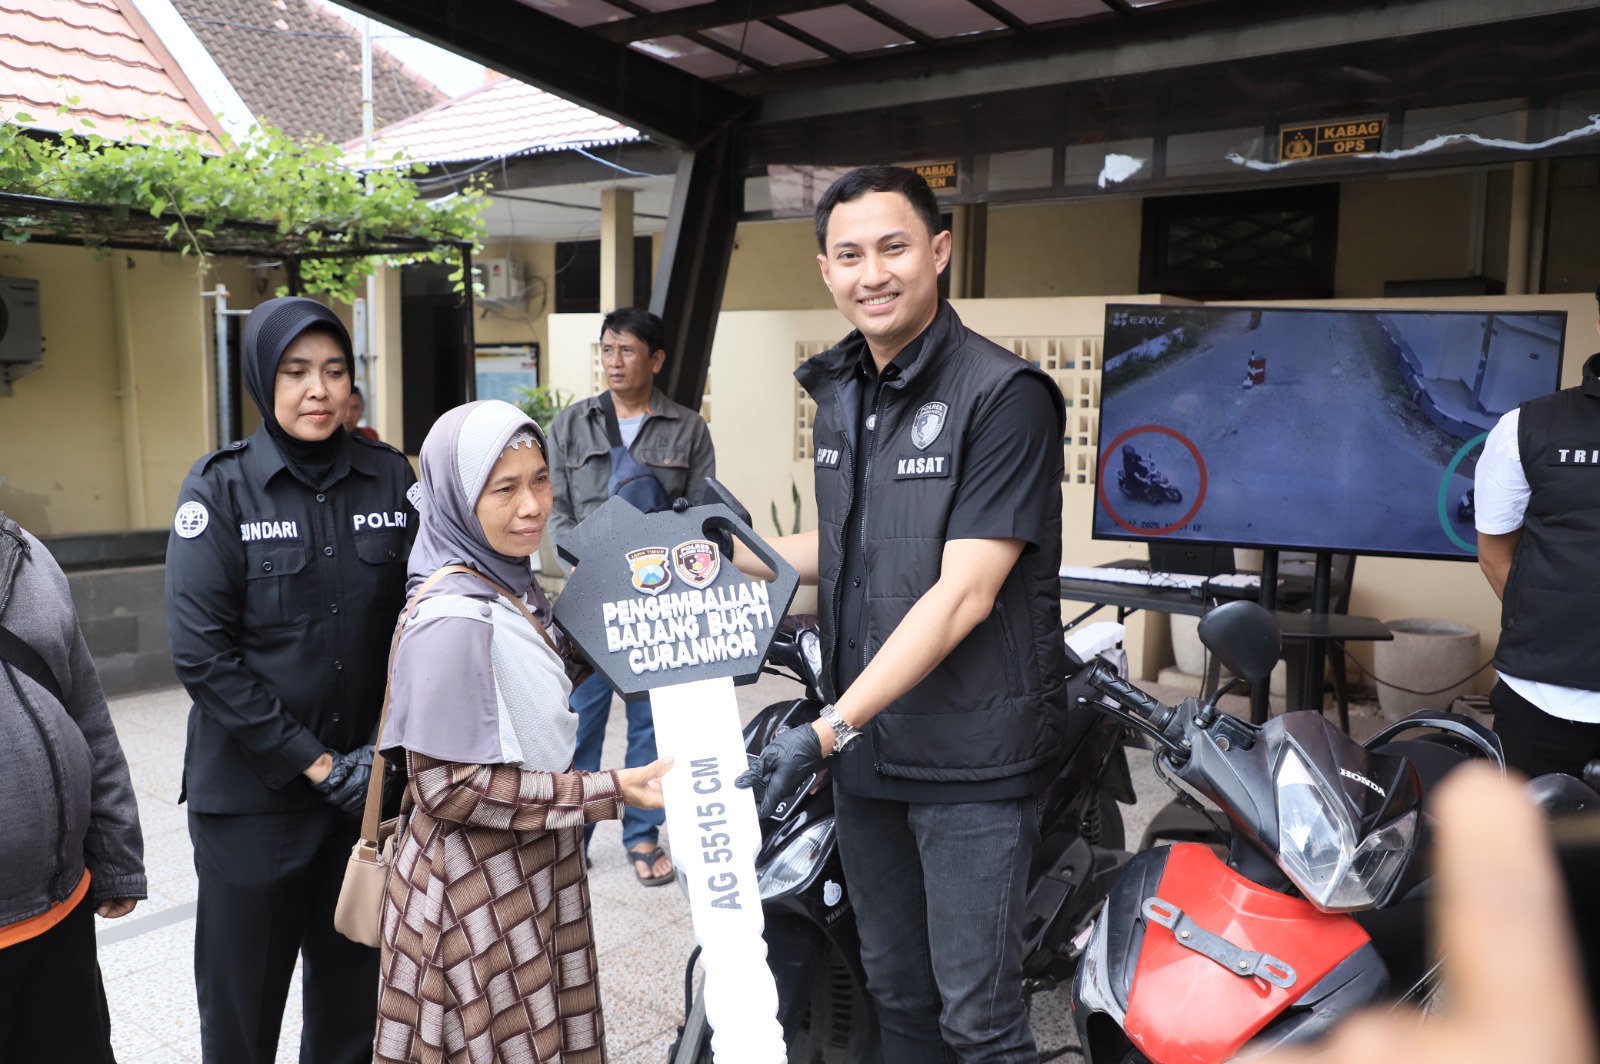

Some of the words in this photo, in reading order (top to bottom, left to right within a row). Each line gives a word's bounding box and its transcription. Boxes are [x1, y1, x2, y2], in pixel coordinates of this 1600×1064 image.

[1324, 122, 1380, 139] KABAG
[1333, 140, 1366, 153] OPS
[916, 165, 955, 176] KABAG
[1129, 315, 1166, 325] EZVIZ
[897, 457, 945, 475] KASAT
[1558, 449, 1599, 464] TRI
[353, 511, 407, 531] POLRI
[630, 551, 646, 559] JAWA
[680, 544, 711, 553] POLRES
[602, 580, 770, 627] PENGEMBALIAN
[606, 615, 700, 653] BARANG
[707, 604, 774, 637] BUKTI
[628, 631, 758, 675] CURANMOR
[690, 757, 722, 794] CM
[1339, 767, 1386, 798] HONDA
[696, 802, 733, 864] 5515
[707, 871, 742, 910] AG
